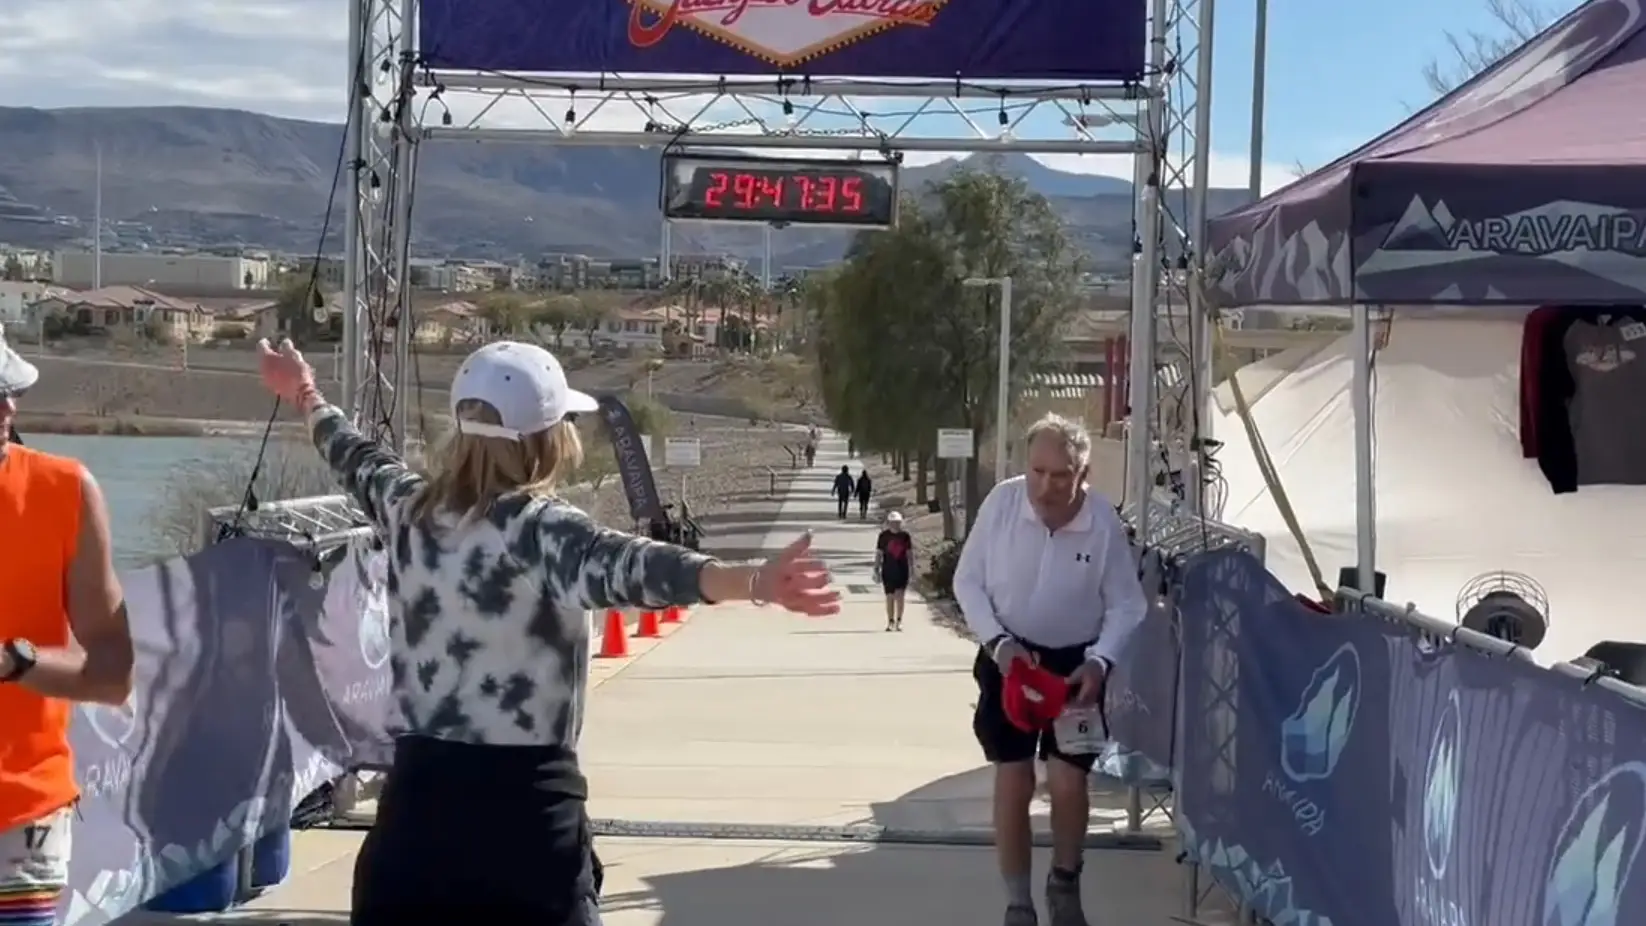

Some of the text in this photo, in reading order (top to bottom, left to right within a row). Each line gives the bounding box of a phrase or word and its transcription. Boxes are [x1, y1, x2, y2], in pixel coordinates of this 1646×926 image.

[705, 172, 863, 212] 29:47:35
[1078, 720, 1088, 734] 6
[24, 825, 52, 850] 17
